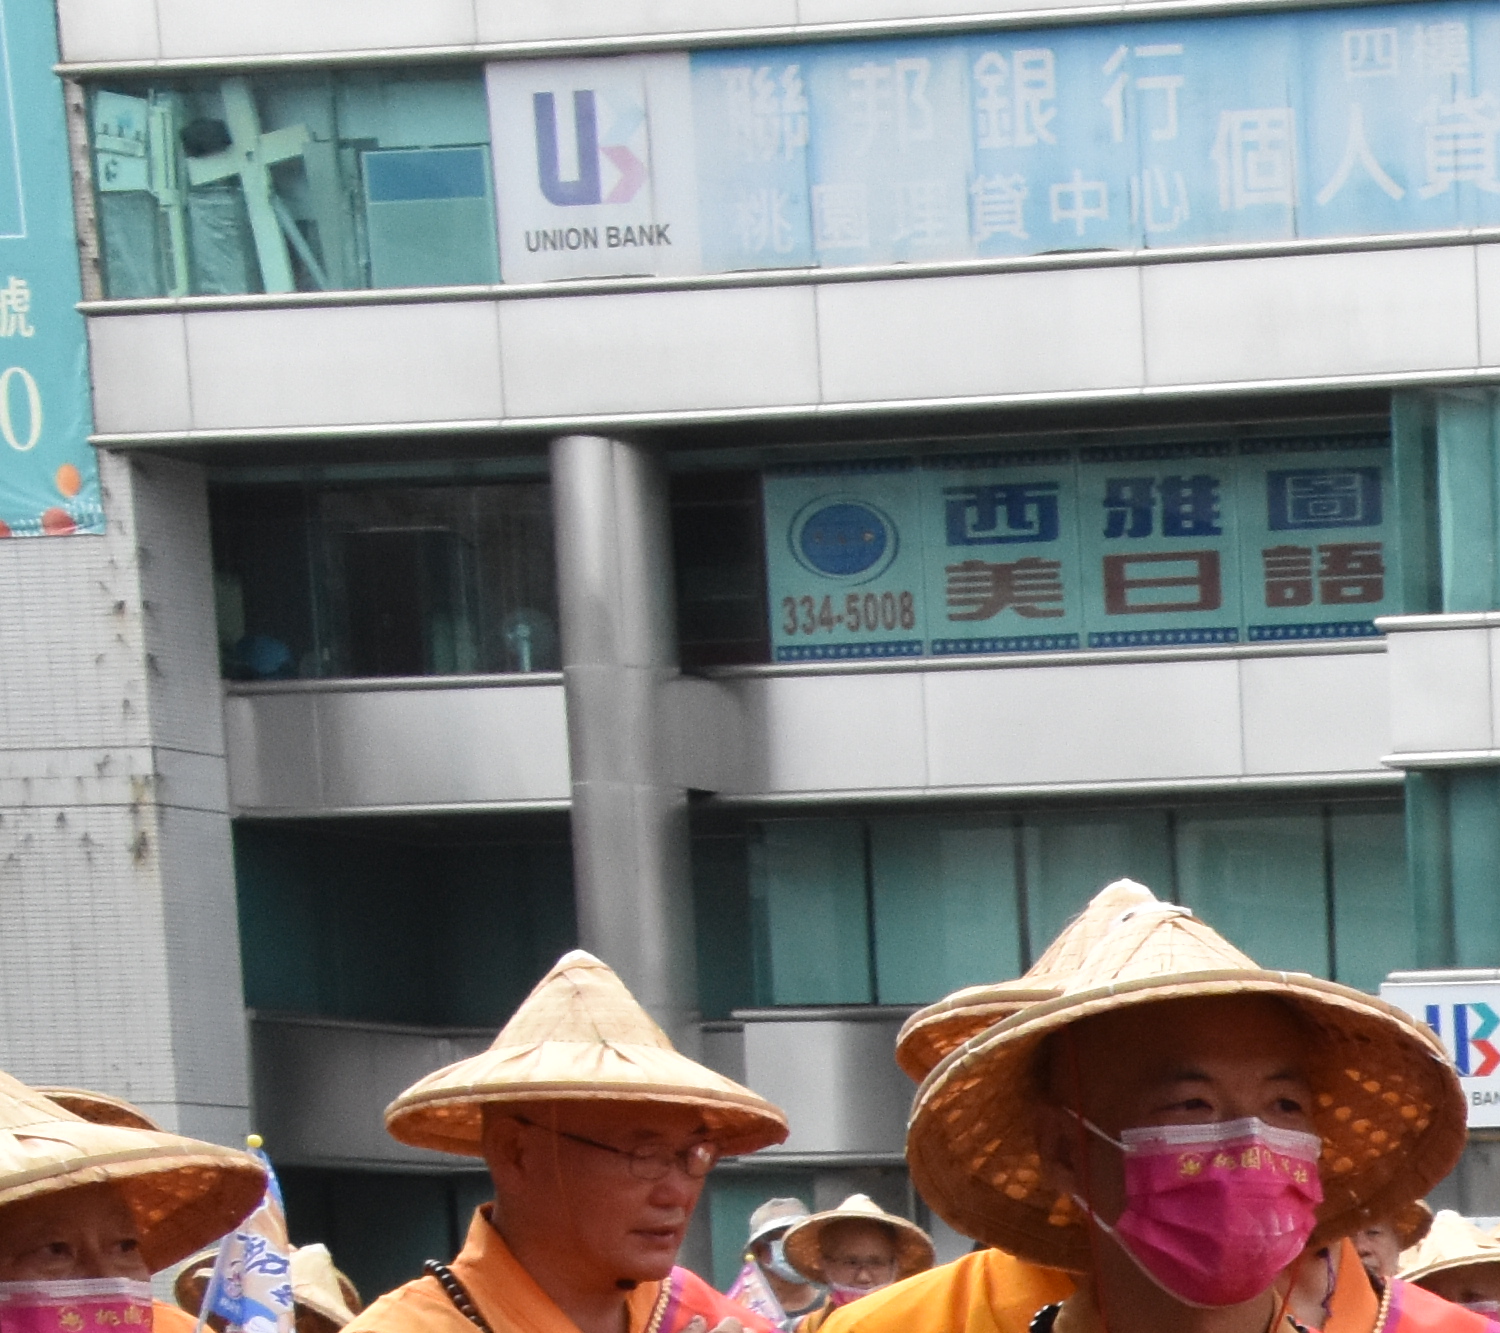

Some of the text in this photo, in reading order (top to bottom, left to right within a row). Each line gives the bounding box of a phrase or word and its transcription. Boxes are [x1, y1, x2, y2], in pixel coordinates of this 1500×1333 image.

[1342, 21, 1469, 79] 四樓
[720, 43, 1185, 162] 聯邦銀行
[525, 224, 672, 252] UNION BANK
[942, 466, 1384, 547] 西雅圖
[782, 590, 916, 637] 334-5008
[944, 541, 1387, 622] 美日語
